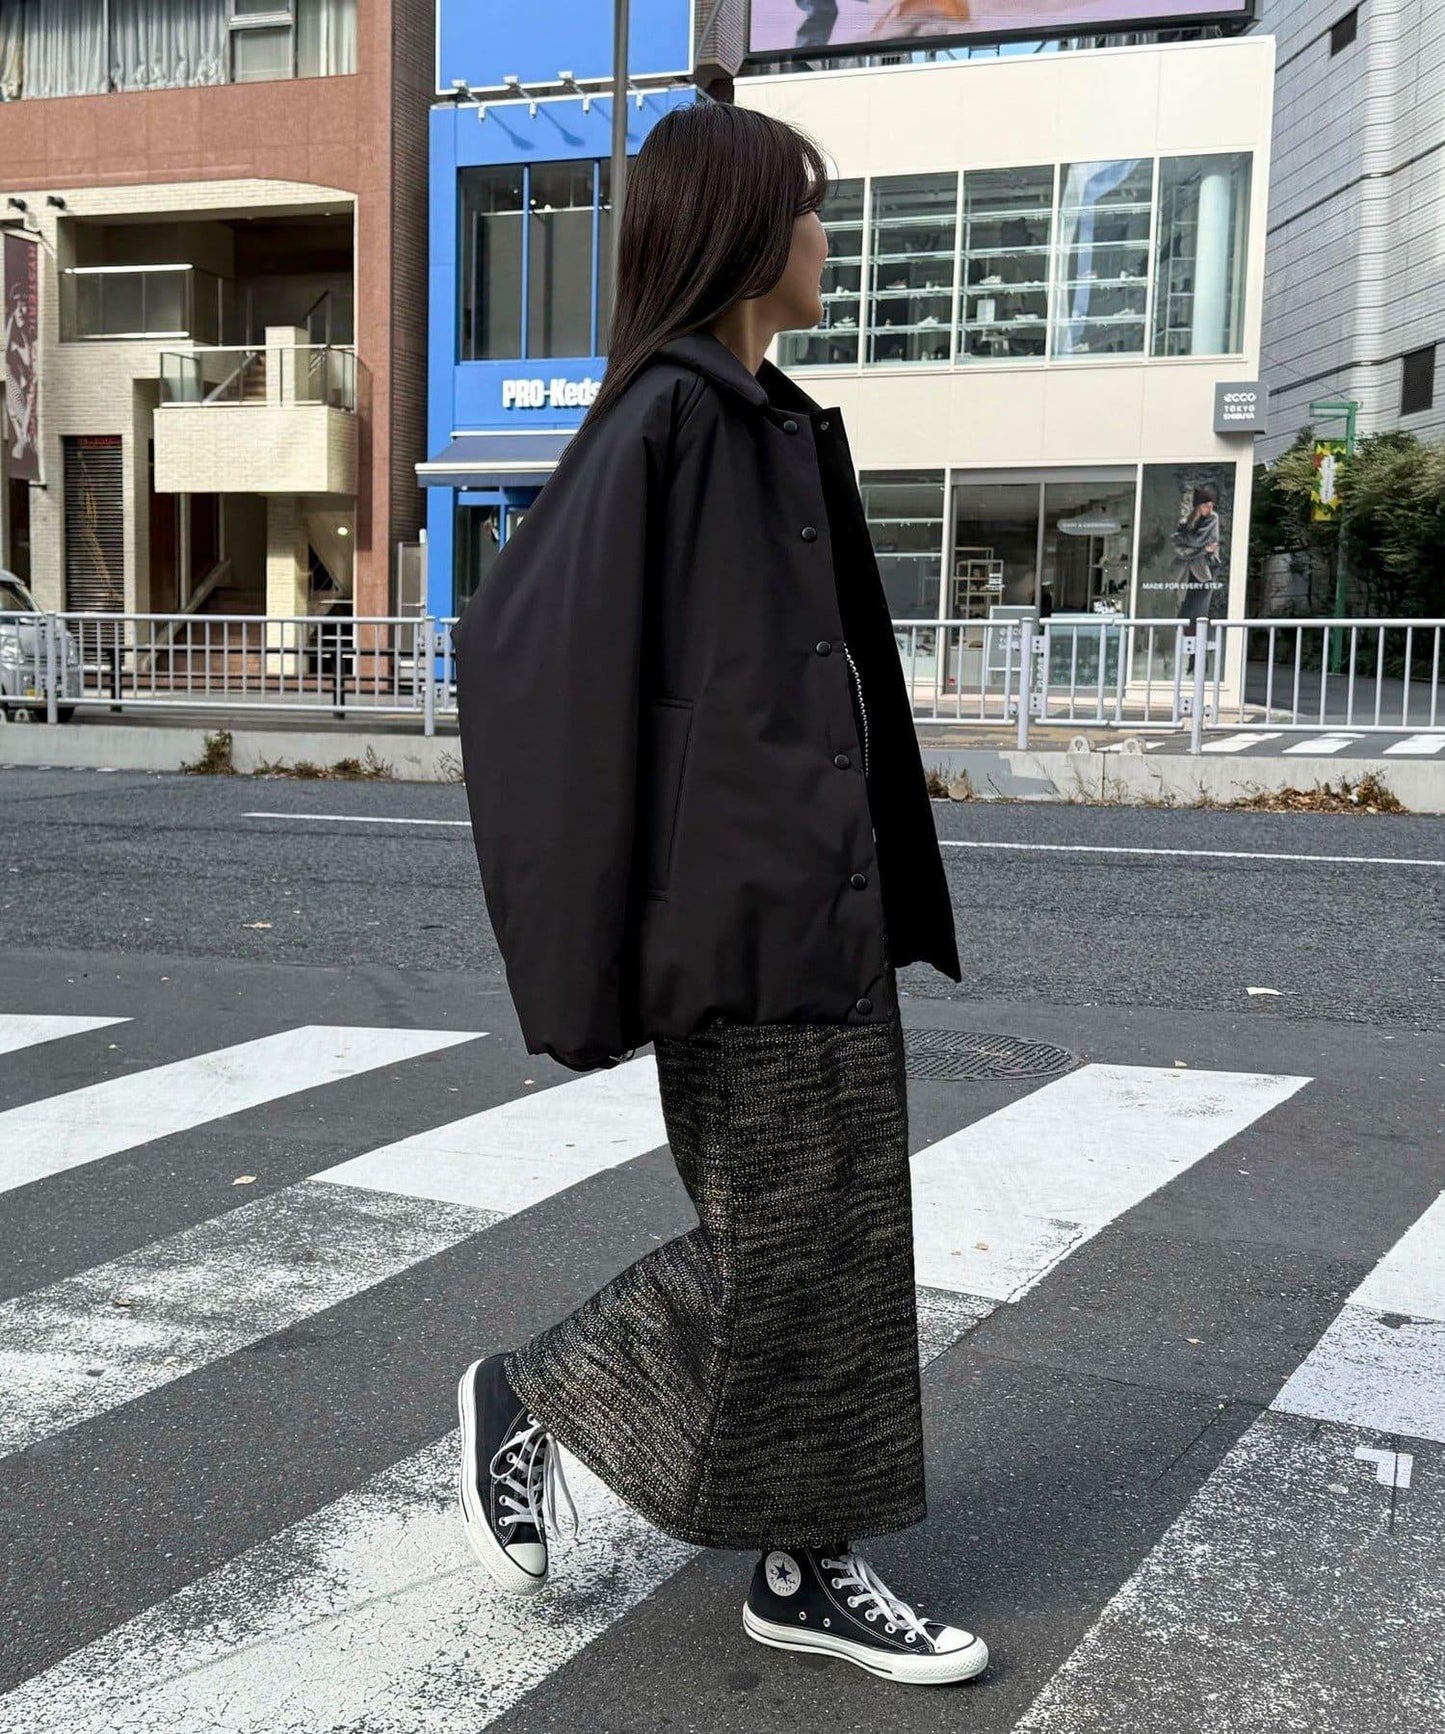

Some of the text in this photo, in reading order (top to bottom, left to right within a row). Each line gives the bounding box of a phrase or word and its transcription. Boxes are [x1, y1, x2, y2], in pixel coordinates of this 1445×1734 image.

[502, 377, 602, 408] PRO-Keds
[1224, 404, 1255, 413] TOKYO
[1143, 582, 1224, 590] MADE FOR EVERY STEP
